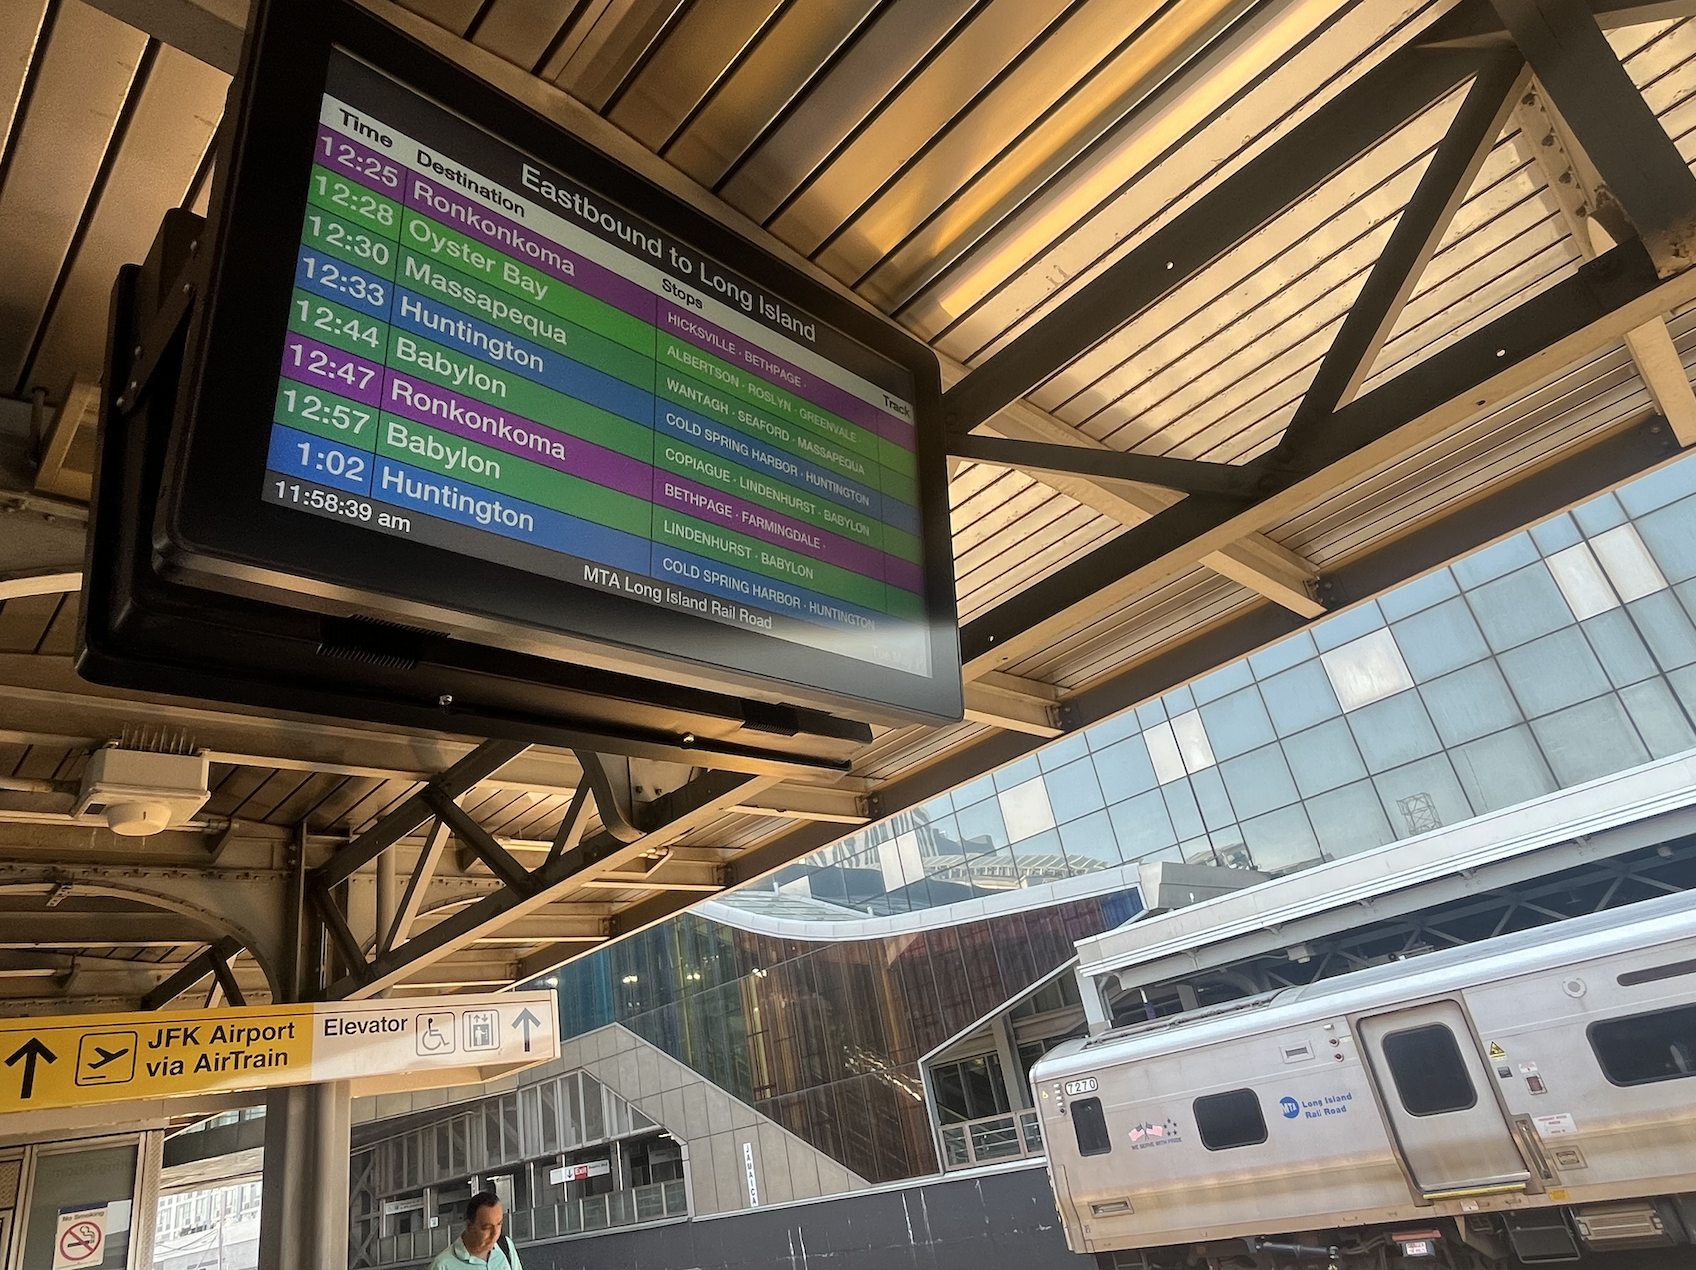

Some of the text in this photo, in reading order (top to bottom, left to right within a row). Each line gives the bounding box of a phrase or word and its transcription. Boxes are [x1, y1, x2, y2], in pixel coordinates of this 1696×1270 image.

[339, 108, 393, 148] Time
[320, 136, 399, 188] 12:25
[415, 149, 525, 218] Destination
[315, 175, 394, 226] 12:28
[308, 215, 389, 266] 12:30
[414, 180, 575, 276] Ronkonkoma
[521, 163, 816, 342] Eastbound to Long Island
[302, 257, 385, 307] 12:33
[409, 219, 549, 301] Oyster Bay
[405, 256, 567, 346] Massapequa
[661, 279, 704, 310] Stops
[296, 299, 380, 348] 12:44
[400, 296, 545, 373] Huntington
[289, 344, 376, 390] 12:47
[396, 336, 507, 398] Babylon
[668, 312, 802, 388] HICKSVILLE BETHPAGE
[283, 389, 370, 435] 12:57
[391, 378, 566, 460] Ronkonkoma
[667, 345, 857, 443] ALBERTSON ROSLYN GREENVALE
[882, 394, 911, 418] Track
[387, 421, 501, 479] Babylon
[667, 377, 866, 476] WANTAGH SEAFORD MASSAPEQUA
[297, 442, 365, 482] 1:02
[666, 413, 870, 507] COLD SPRING HARBOR HUNTINGTON
[275, 480, 411, 533] 11:58:39 am
[382, 466, 535, 532] Huntington
[665, 448, 870, 537] COPIAGUE LINDENHURST BABYLON
[665, 483, 821, 549] BETHPAGE FARMINGDALE
[664, 520, 814, 580] LINDENHURST BABYLON
[583, 564, 773, 630] MTA Long Island Rail Road
[663, 557, 875, 631] COLD SPRING HARBOR HUNTINGTON
[148, 1021, 296, 1049] JFK Airport
[324, 1016, 408, 1037] Elevator
[146, 1049, 288, 1077] via AirTrain
[1068, 1080, 1096, 1093] 7270
[1280, 1102, 1297, 1114] MTA
[1302, 1092, 1353, 1108] Long Island
[1305, 1105, 1347, 1118] Rail Road
[574, 1166, 588, 1176] Exit
[74, 1211, 105, 1220] Smoking
